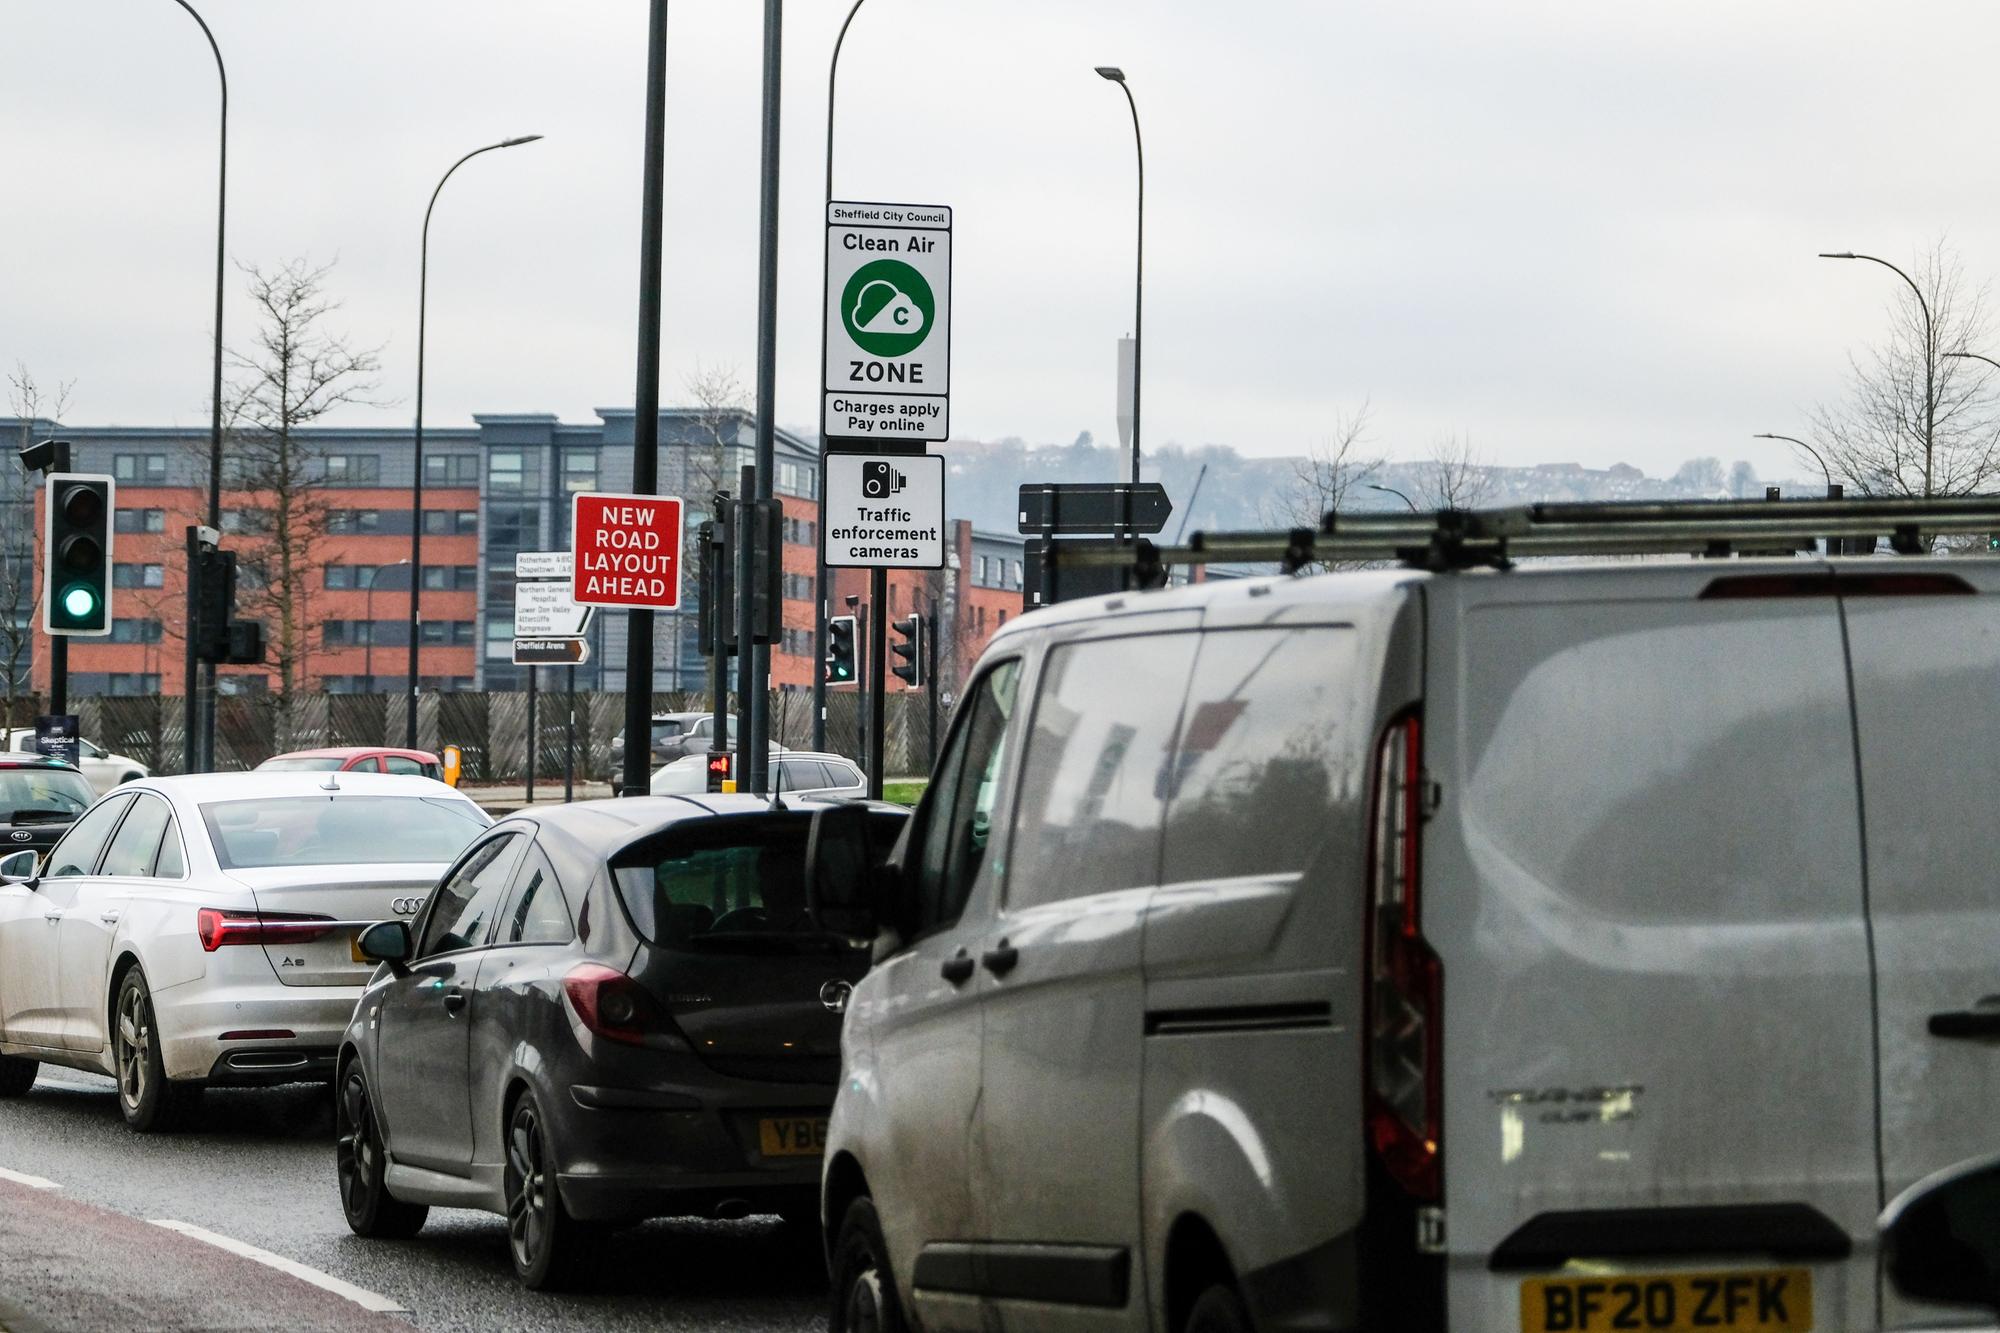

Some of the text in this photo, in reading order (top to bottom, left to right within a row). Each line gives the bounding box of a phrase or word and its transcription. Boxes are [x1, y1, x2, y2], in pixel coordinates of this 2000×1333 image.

[834, 209, 945, 223] Sheffield City Council
[843, 233, 935, 253] Clean Air
[893, 306, 909, 326] C
[849, 361, 923, 383] ZONE
[833, 400, 940, 418] Charges apply
[848, 417, 925, 431] Pay online
[602, 506, 655, 526] NEW
[857, 507, 911, 522] Traffic
[595, 530, 660, 550] ROAD
[831, 526, 937, 541] enforcement
[849, 547, 919, 559] cameras
[584, 552, 671, 574] LAYOUT
[586, 576, 665, 597] AHEAD
[552, 606, 571, 614] Valley
[516, 641, 565, 649] Sheffield Arena
[41, 736, 74, 744] Skeptical
[1544, 1275, 1790, 1331] BF20 ZFK
